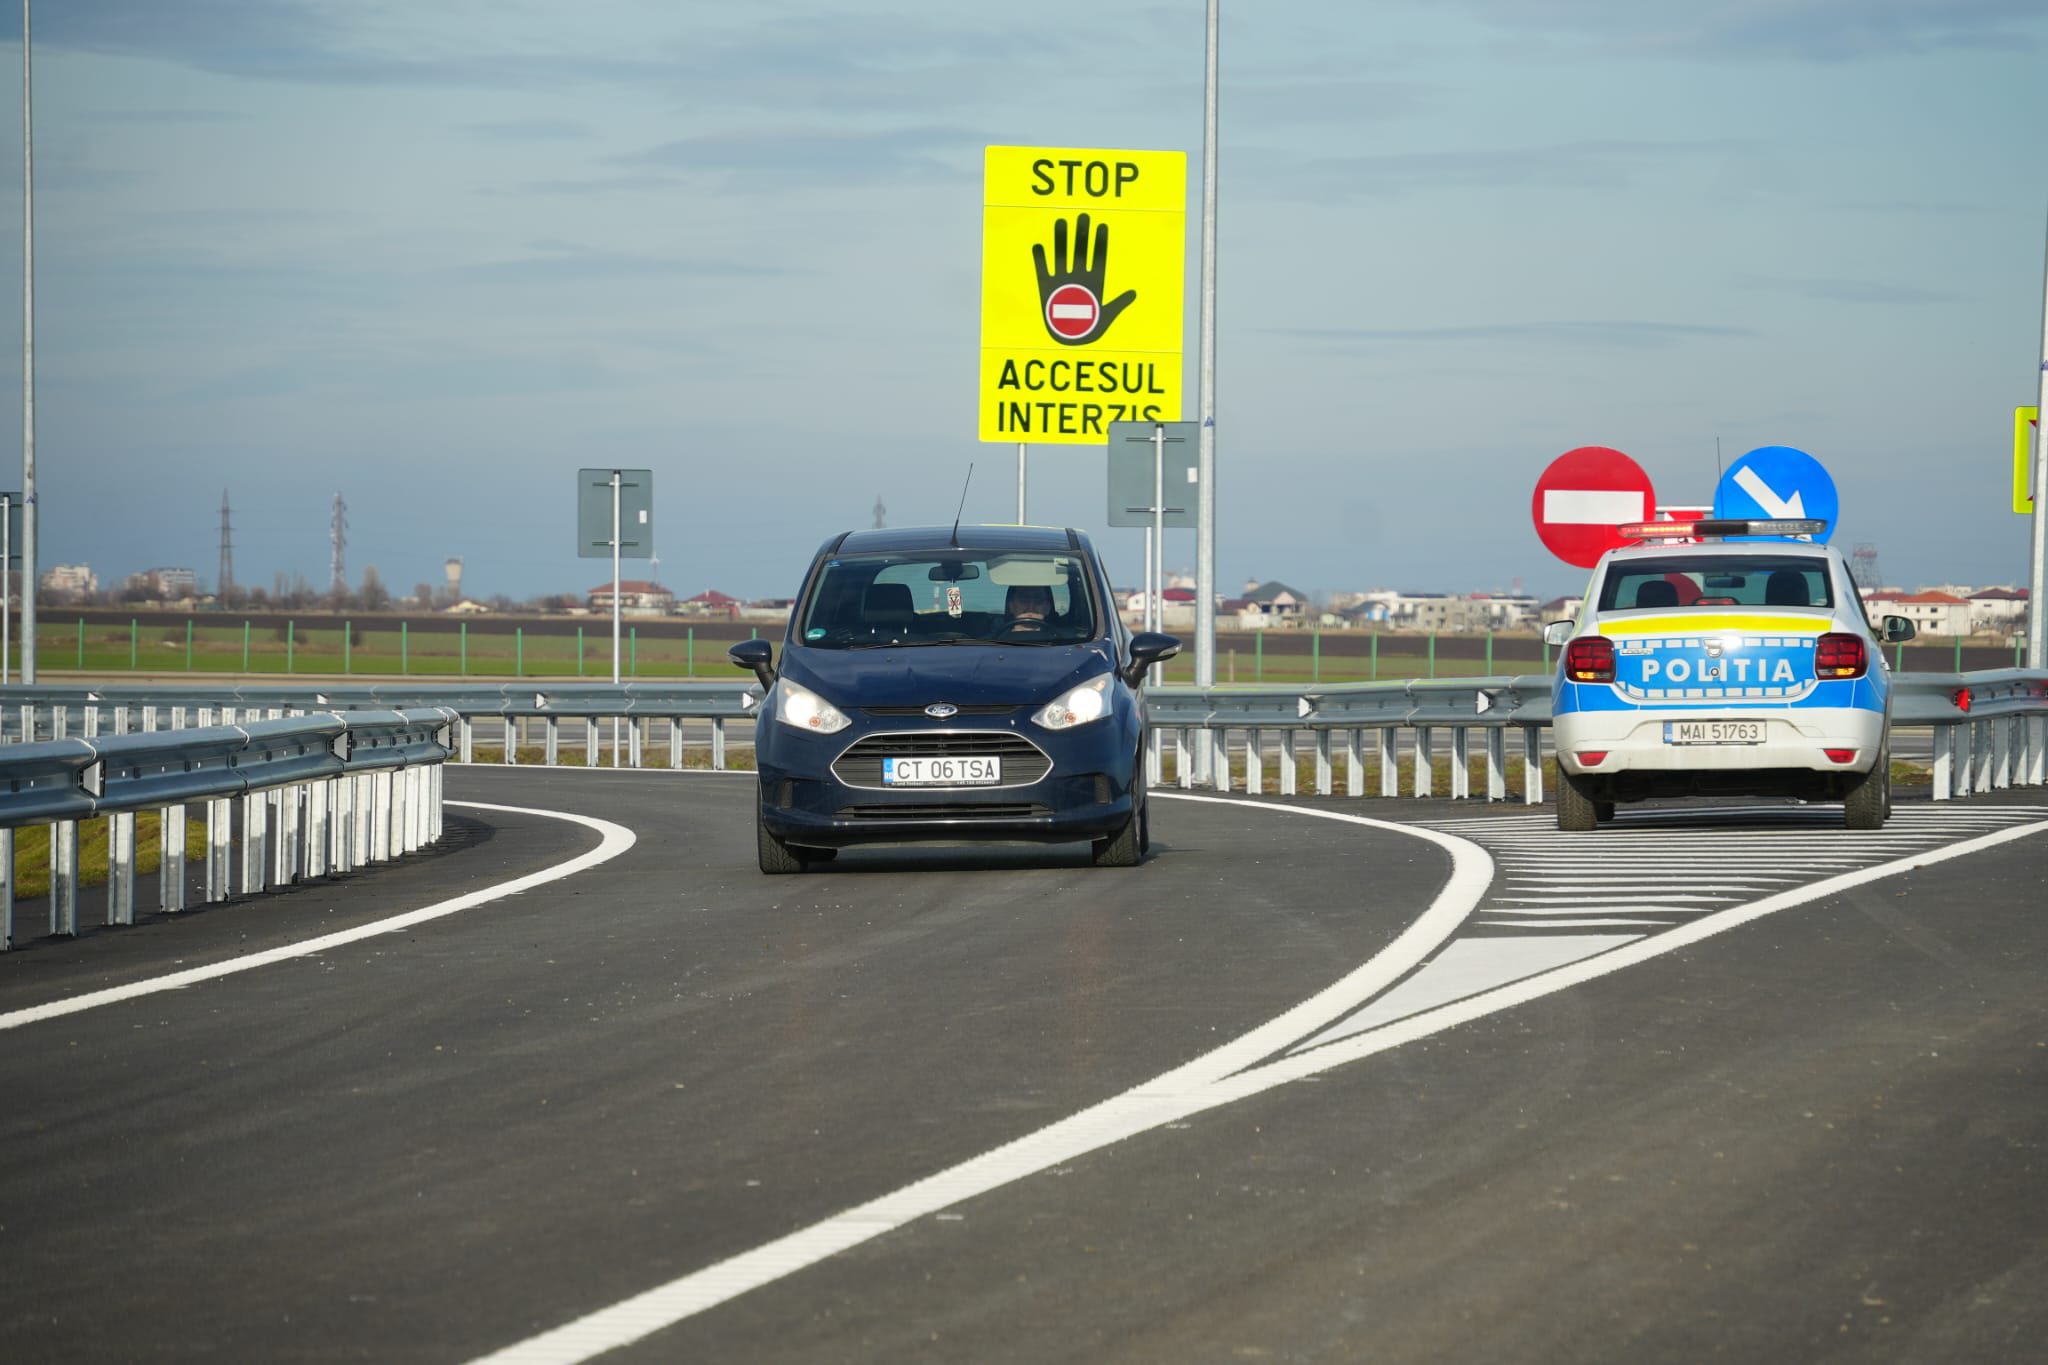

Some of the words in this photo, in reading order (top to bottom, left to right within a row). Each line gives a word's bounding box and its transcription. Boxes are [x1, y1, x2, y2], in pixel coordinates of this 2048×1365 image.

[1031, 159, 1139, 198] STOP
[998, 359, 1165, 394] ACCESUL
[1642, 658, 1795, 682] POLITIA
[1680, 724, 1705, 739] MAI
[1711, 724, 1758, 739] 51763
[897, 761, 922, 779] CT
[930, 760, 953, 779] 06
[957, 760, 995, 779] TSA
